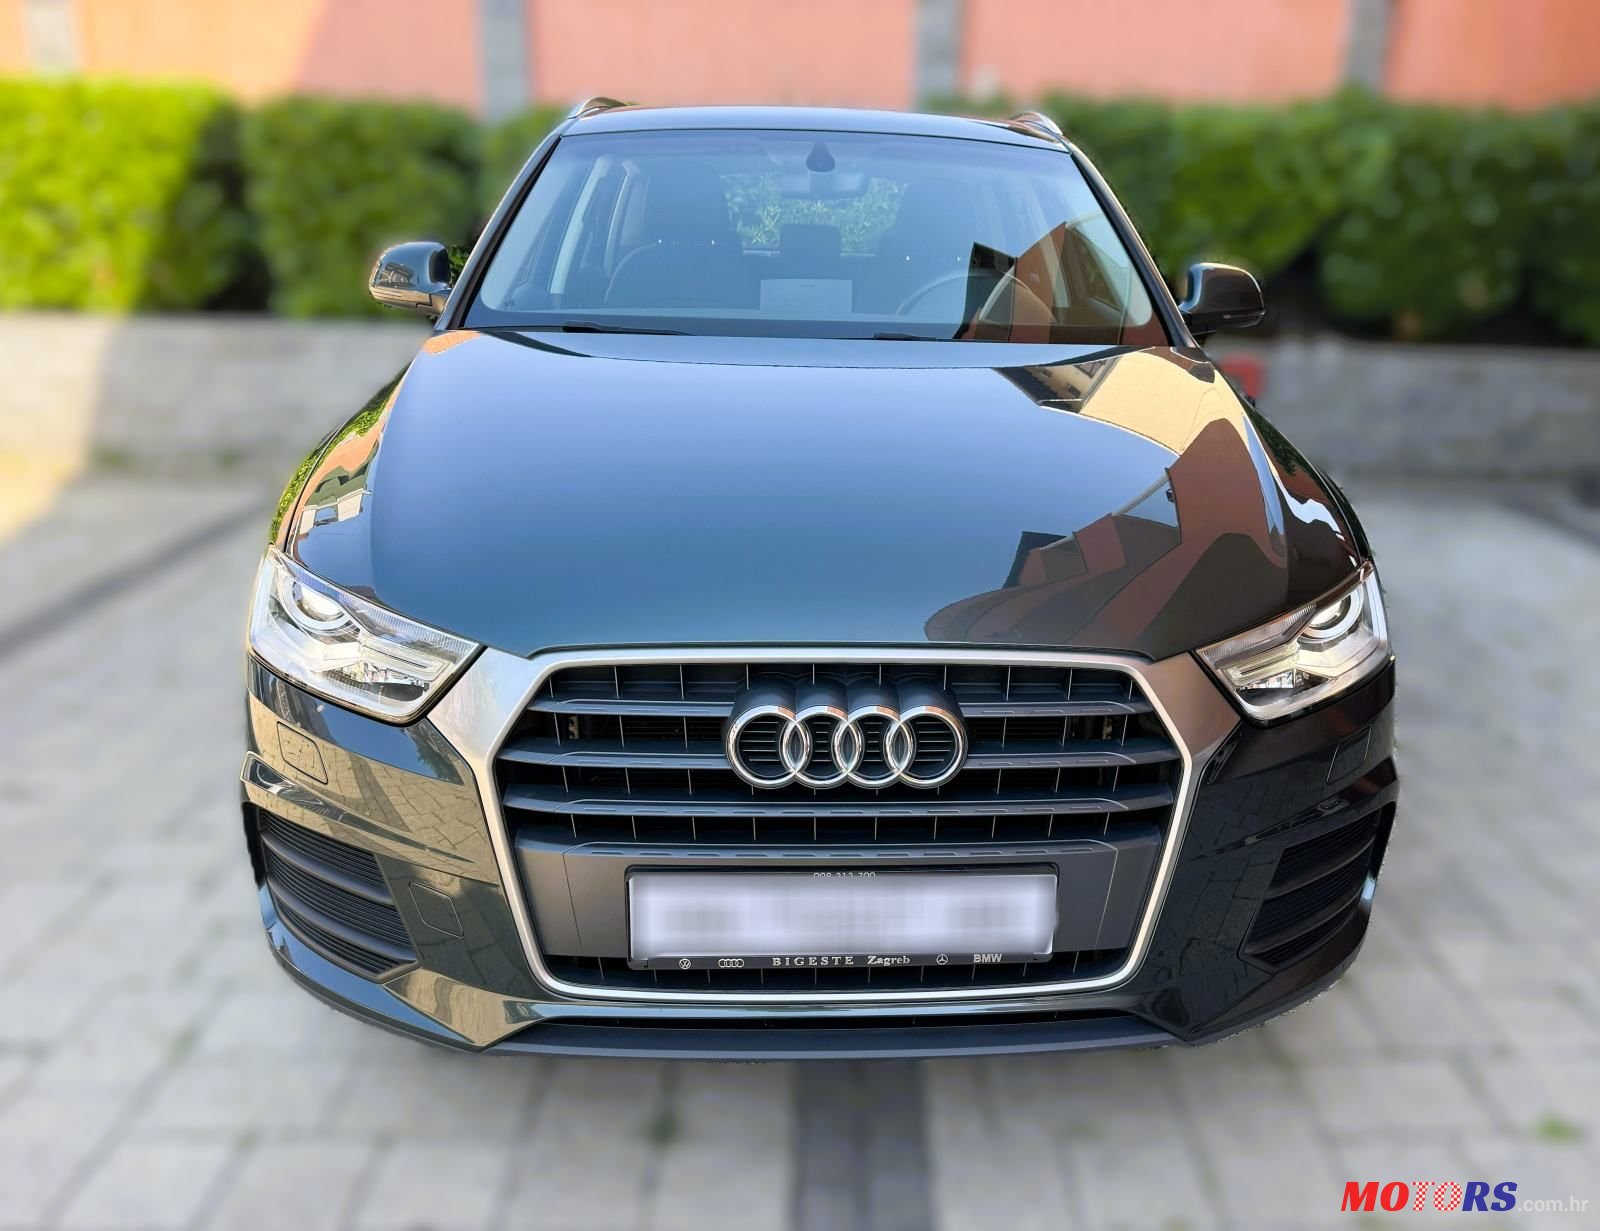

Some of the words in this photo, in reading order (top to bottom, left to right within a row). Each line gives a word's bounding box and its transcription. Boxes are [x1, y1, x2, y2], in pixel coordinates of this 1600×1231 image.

[772, 956, 854, 967] BIGESTE
[867, 955, 910, 967] Zagreb
[973, 953, 1003, 963] BMW
